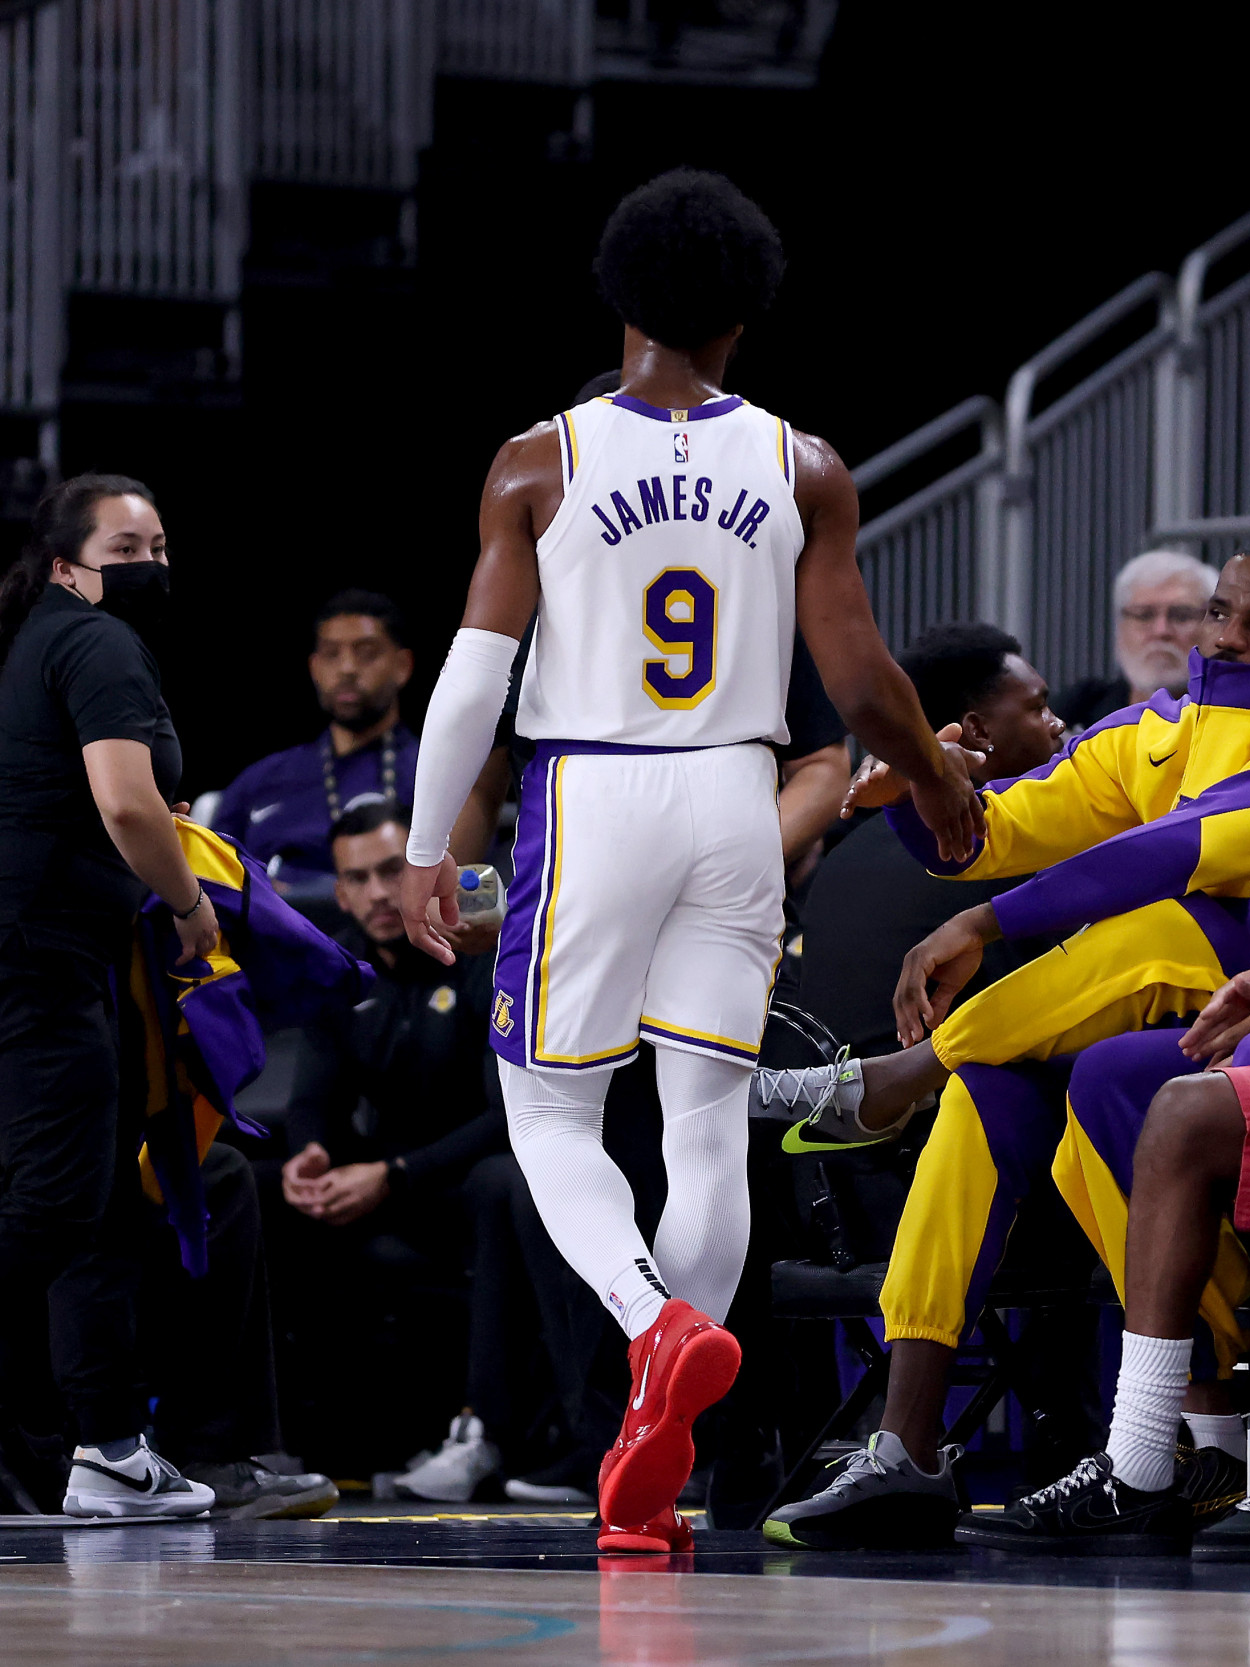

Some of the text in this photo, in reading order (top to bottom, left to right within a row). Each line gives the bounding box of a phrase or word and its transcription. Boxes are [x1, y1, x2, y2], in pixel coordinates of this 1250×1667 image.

[591, 475, 770, 549] JAMES JR.
[642, 566, 719, 710] 9
